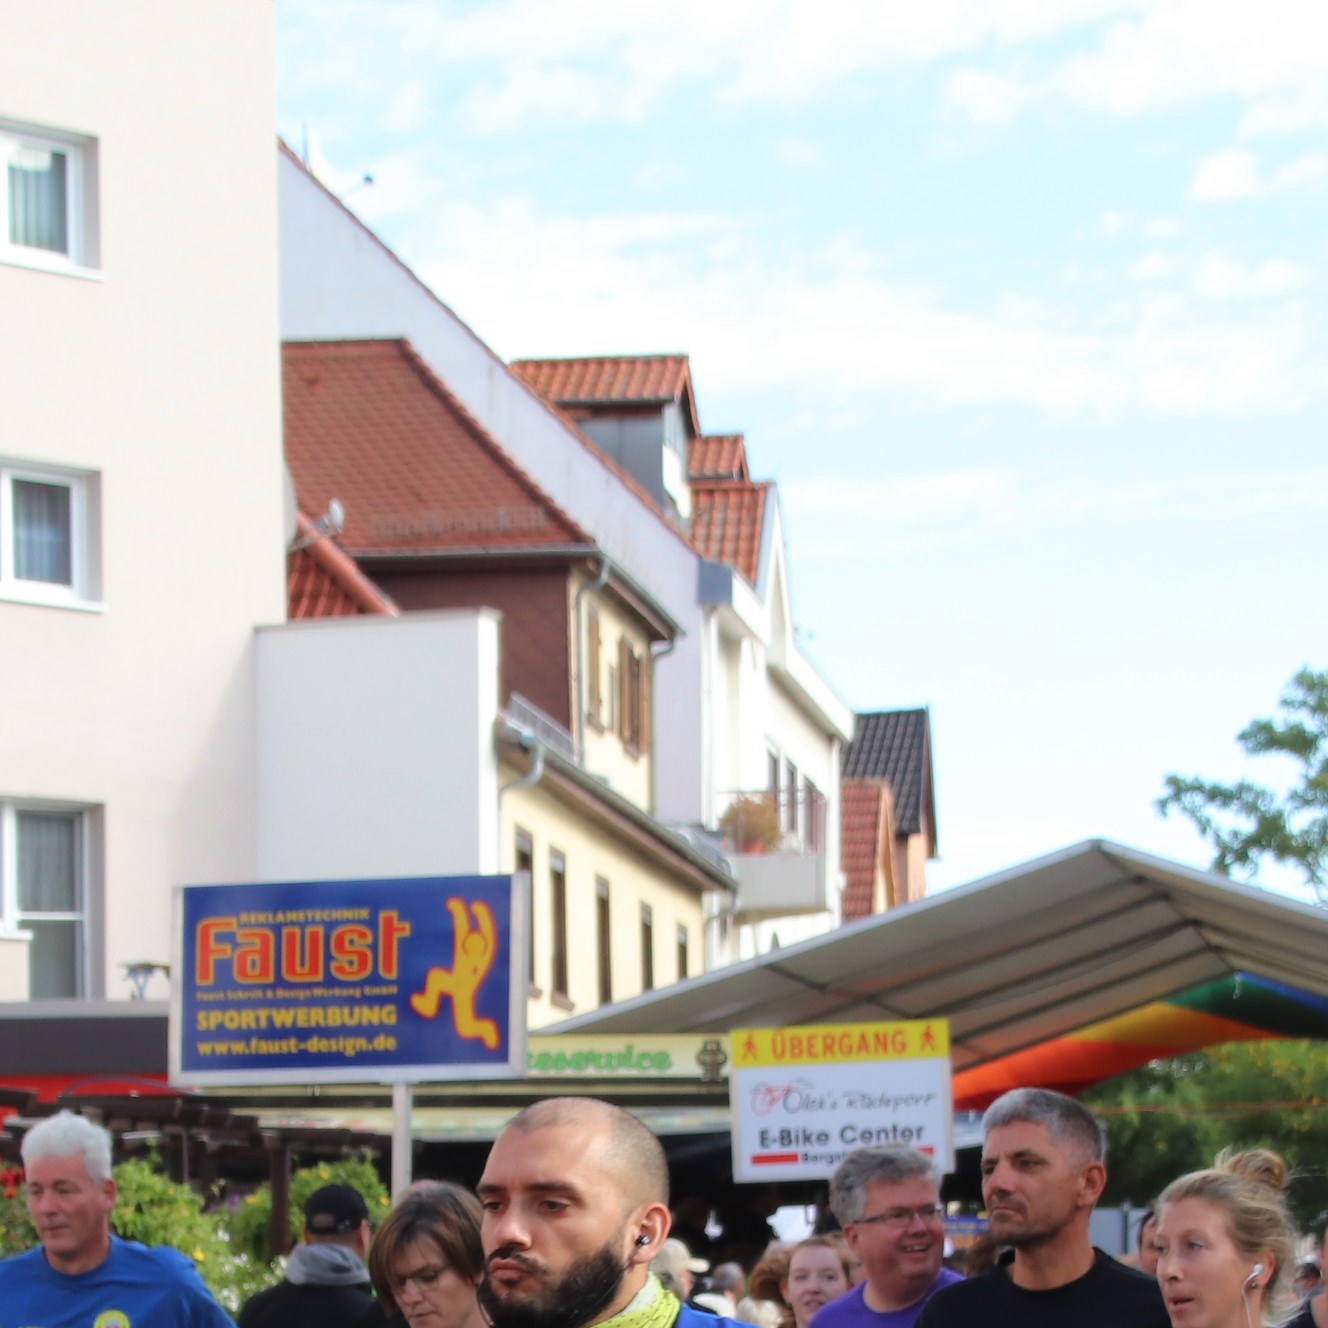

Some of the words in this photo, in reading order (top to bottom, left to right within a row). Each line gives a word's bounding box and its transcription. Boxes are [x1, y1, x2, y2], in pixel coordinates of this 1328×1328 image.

[239, 908, 370, 925] REKLAMETECHNIK
[196, 909, 411, 986] Faust
[197, 1003, 398, 1031] SPORTWERBUNG
[197, 1034, 398, 1057] www.faust-design.de
[771, 1029, 908, 1061] ÜBERGANG
[759, 1127, 830, 1148] E-Bike
[839, 1123, 924, 1145] Center
